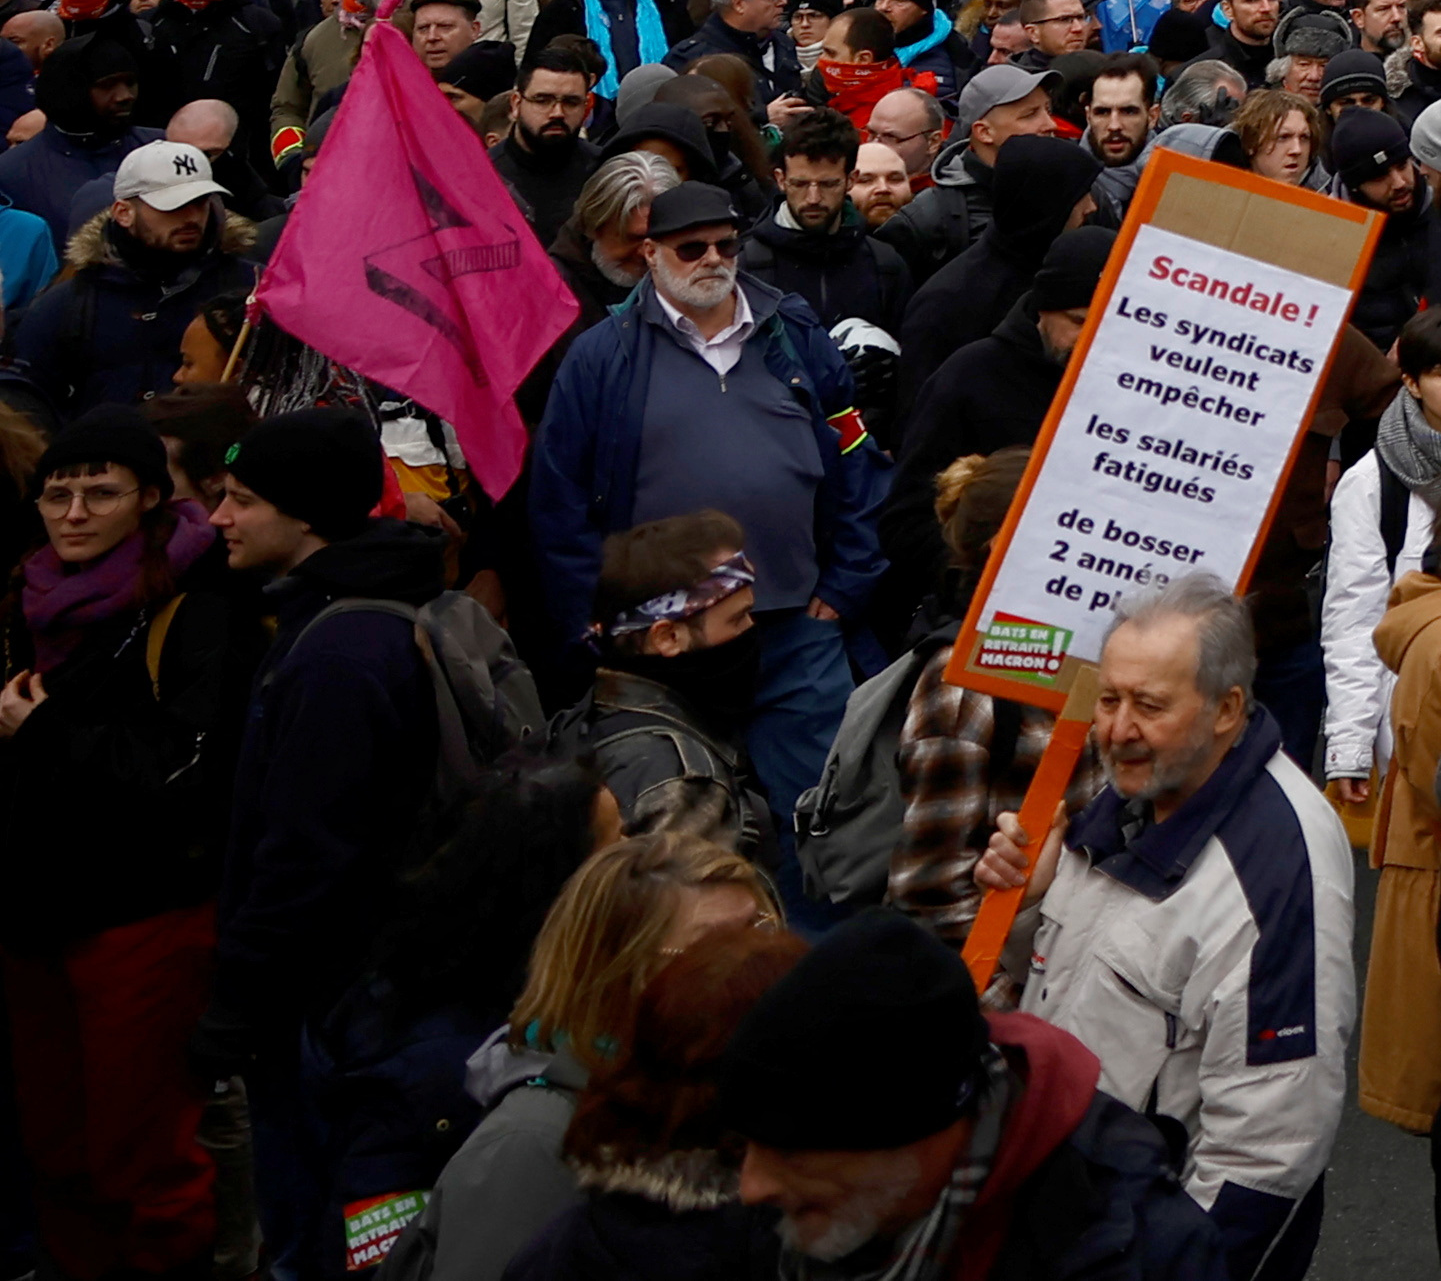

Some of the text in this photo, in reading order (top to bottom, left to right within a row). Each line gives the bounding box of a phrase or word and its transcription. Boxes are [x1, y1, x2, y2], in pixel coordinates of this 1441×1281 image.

[173, 154, 198, 175] NY
[1148, 255, 1301, 323] Scandale
[1116, 296, 1315, 375] Les syndicats
[1148, 344, 1260, 393] veulent
[1117, 369, 1265, 429] empêcher
[1085, 414, 1255, 481] les salariés
[1092, 451, 1216, 505] fatigués
[1048, 540, 1069, 561] 2
[1057, 507, 1204, 565] de bosser
[1045, 574, 1081, 601] de
[983, 639, 1050, 655] RETRAITE
[990, 626, 1049, 641] BATS EN
[980, 653, 1046, 669] MACRON
[350, 1196, 417, 1231] BATS EN
